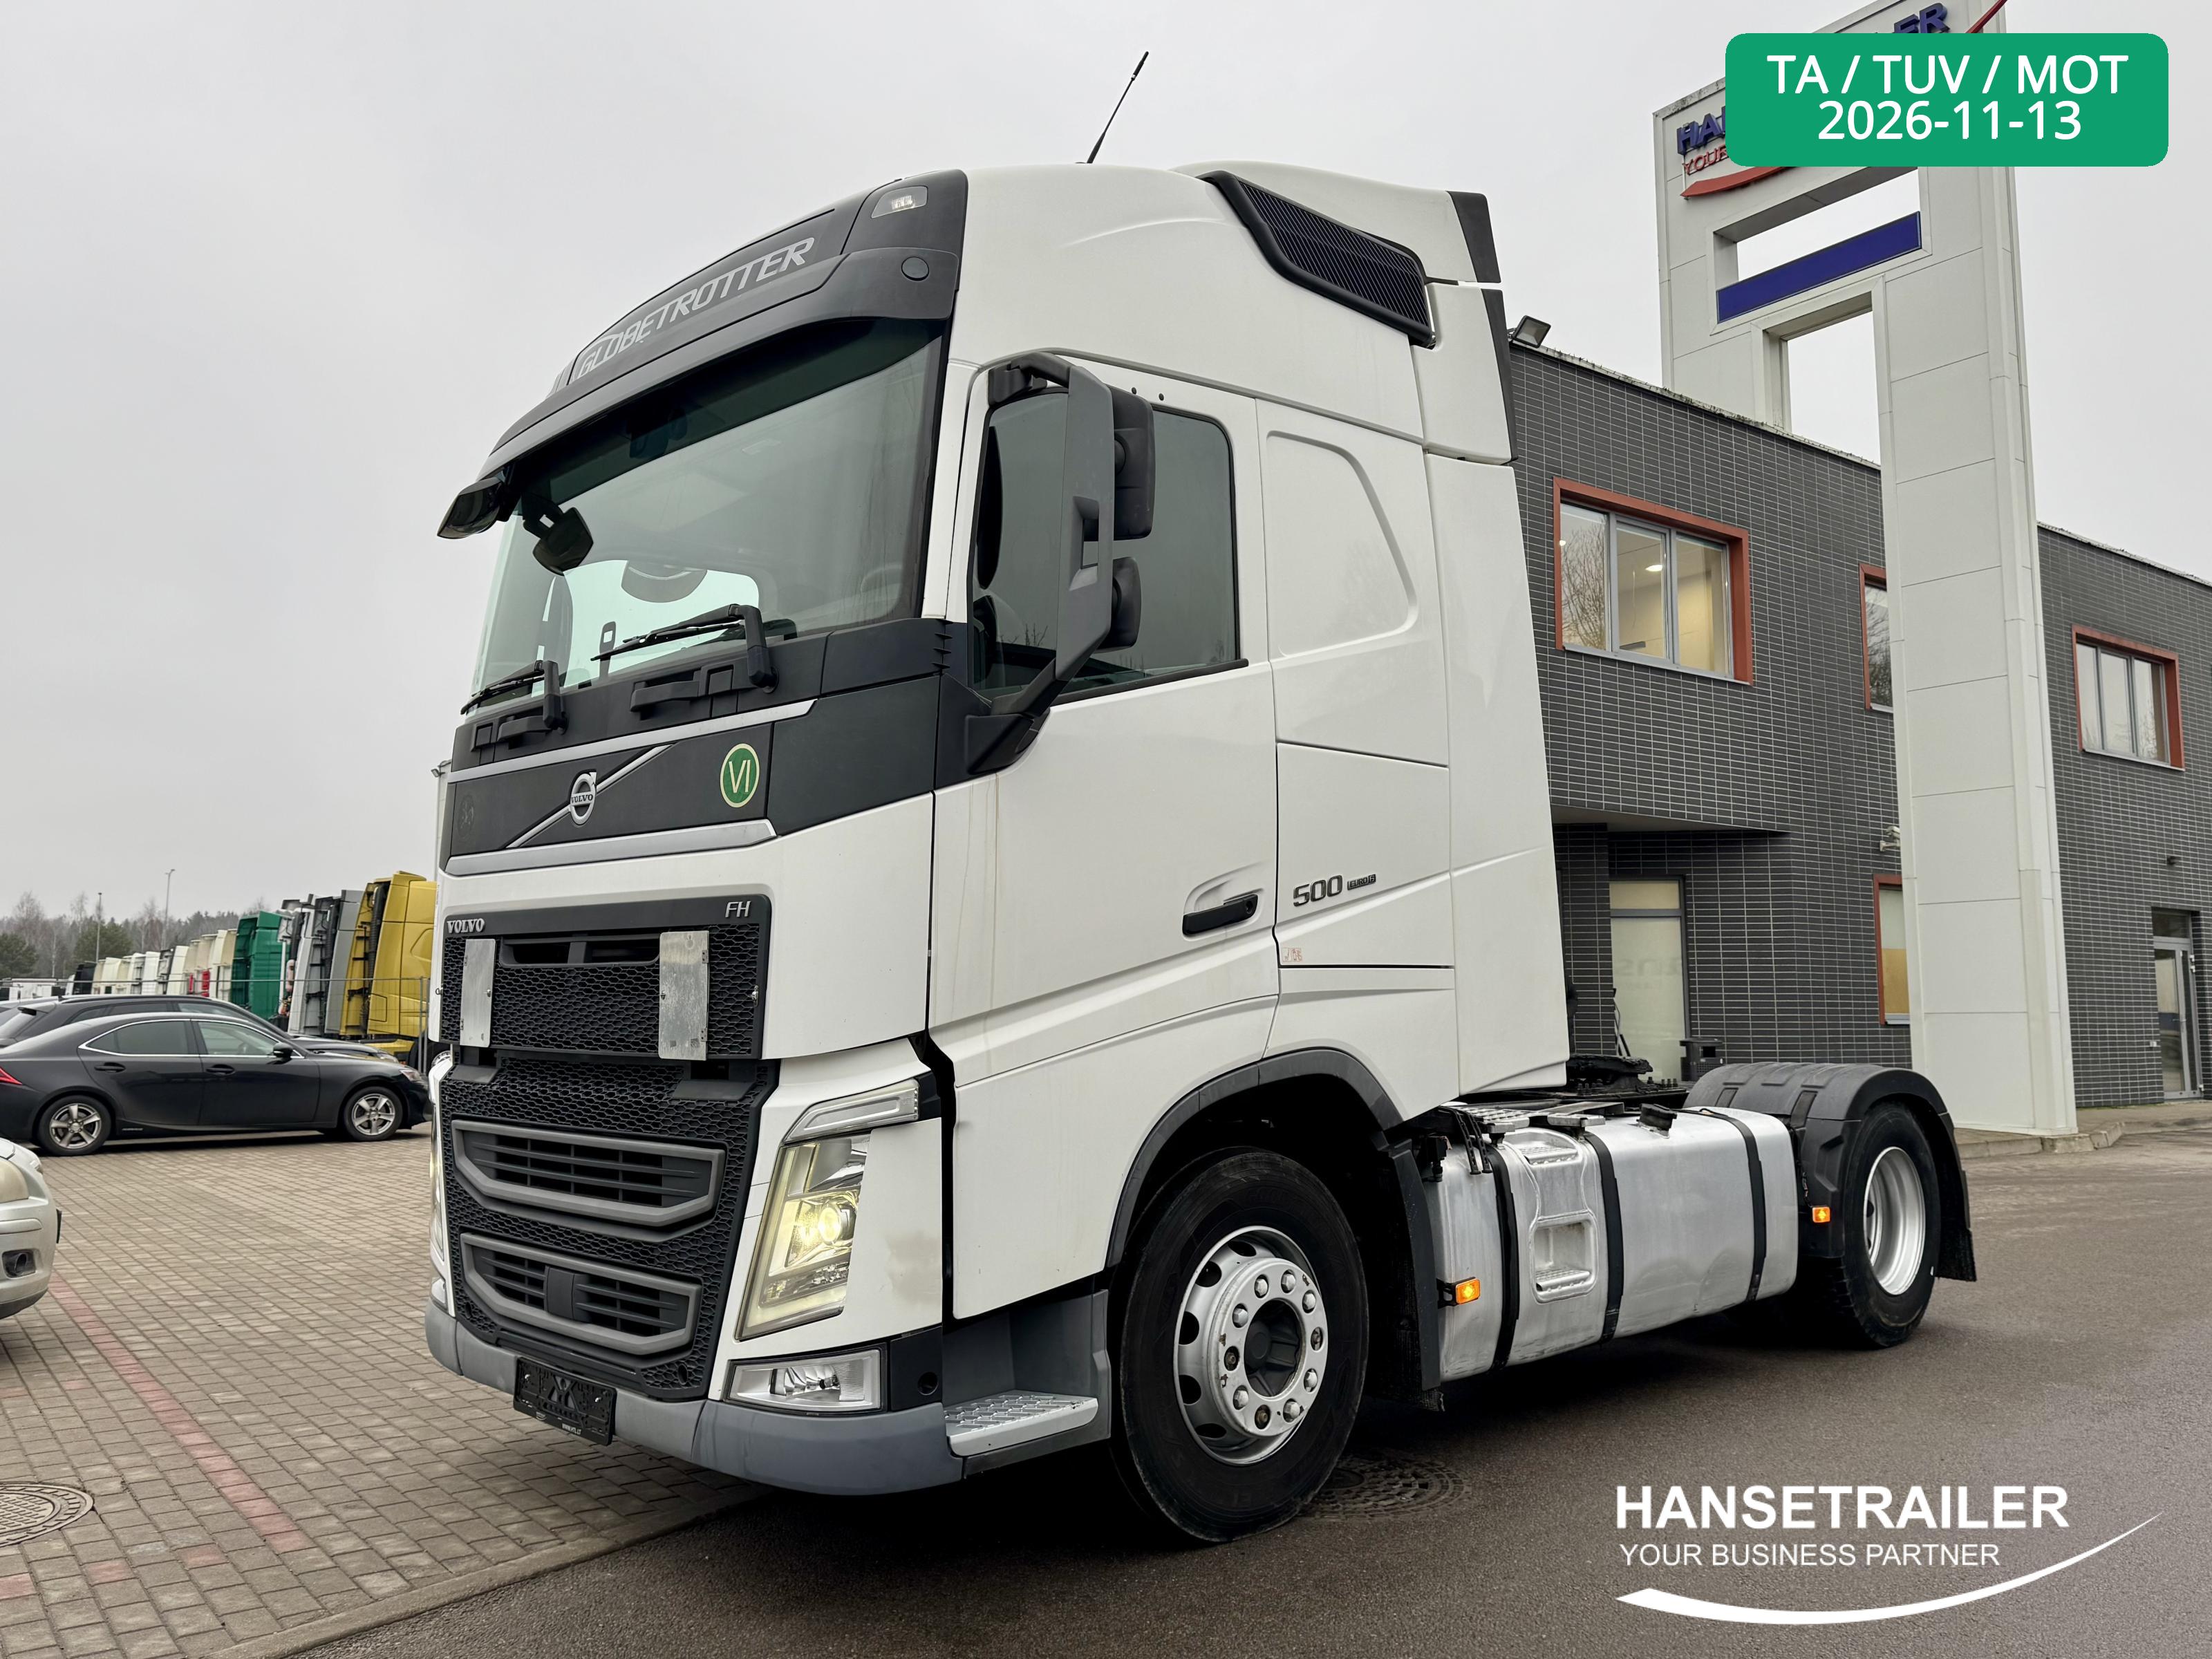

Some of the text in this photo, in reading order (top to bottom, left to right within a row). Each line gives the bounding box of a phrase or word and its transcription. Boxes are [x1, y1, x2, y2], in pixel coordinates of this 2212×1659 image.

[577, 236, 814, 379] GLOBETROTTER
[729, 758, 751, 794] VI
[571, 794, 594, 803] VOLVO
[1293, 874, 1343, 907] 500
[725, 901, 751, 918] FH
[447, 918, 485, 934] VOLVO
